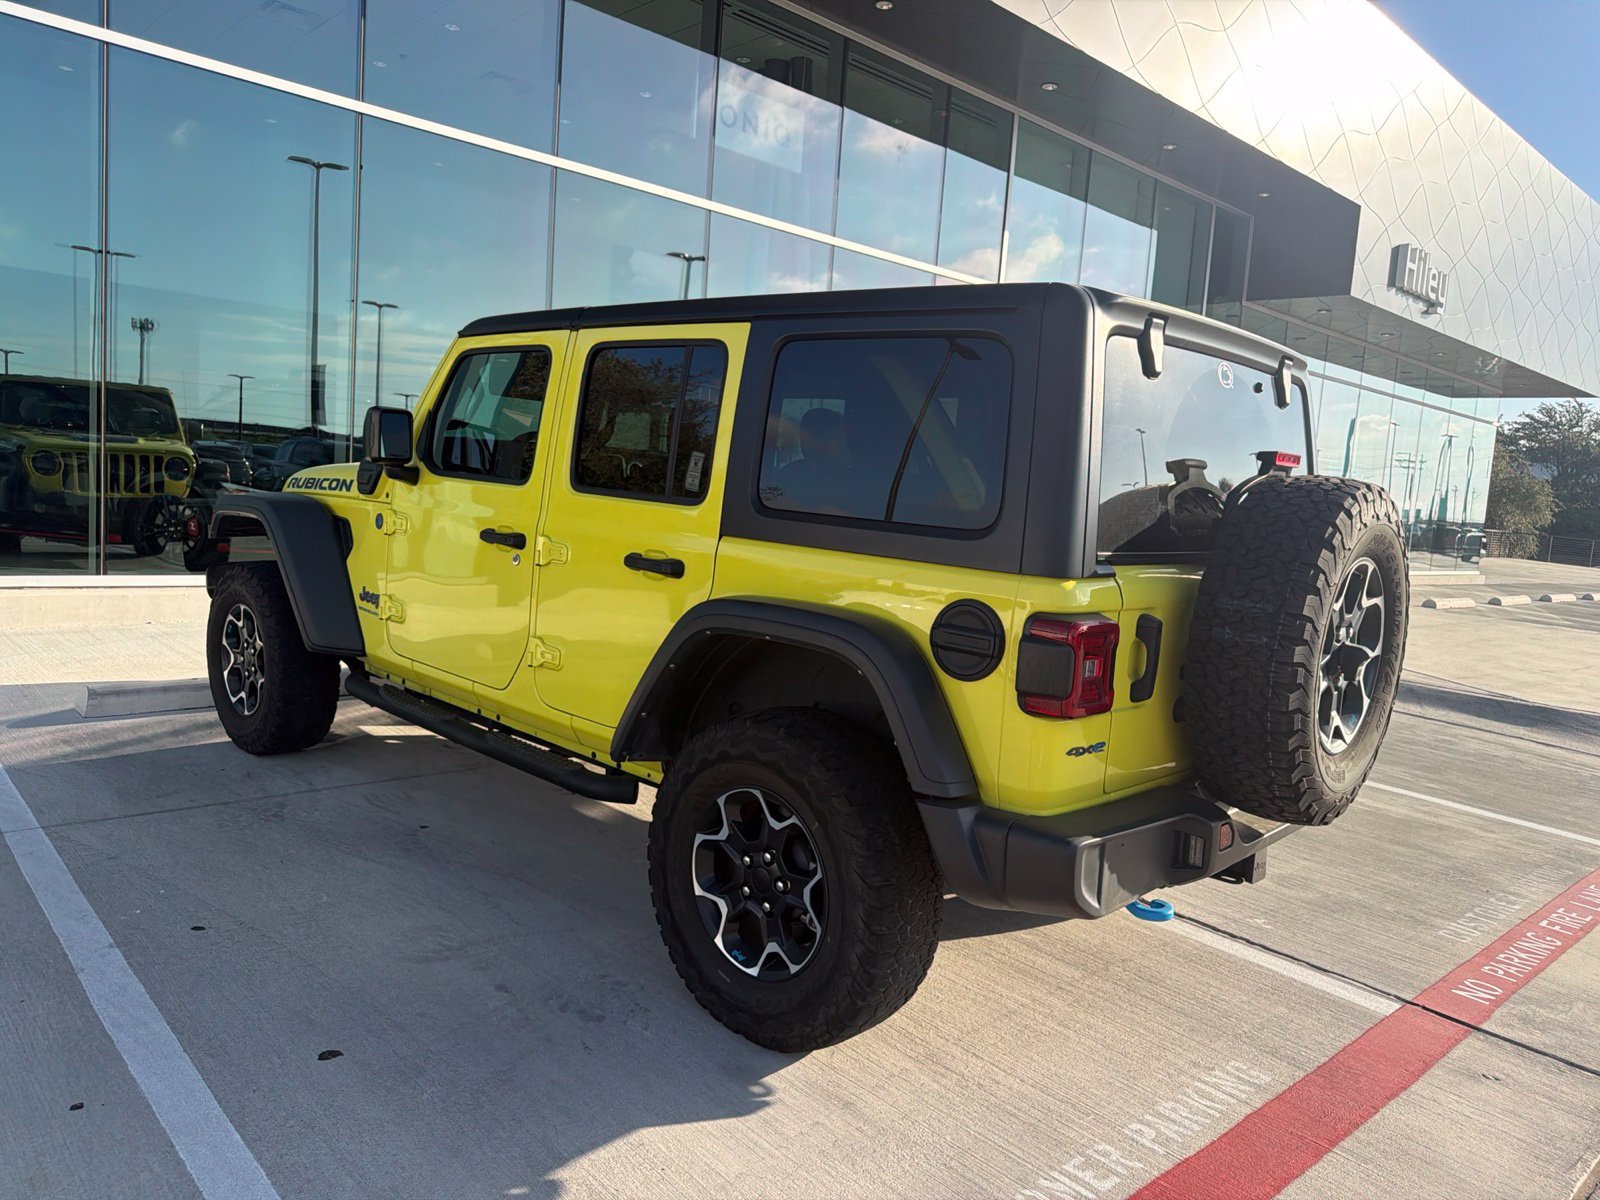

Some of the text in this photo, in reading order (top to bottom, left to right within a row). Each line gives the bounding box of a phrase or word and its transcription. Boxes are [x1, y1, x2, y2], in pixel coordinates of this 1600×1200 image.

[1402, 243, 1449, 315] Hiley
[286, 477, 355, 492] RUBICON
[359, 585, 380, 610] Jeep
[1451, 978, 1503, 1005] NO
[1481, 932, 1562, 982] PARKING
[1539, 907, 1593, 935] FIRE
[1123, 1060, 1273, 1156] PARKING
